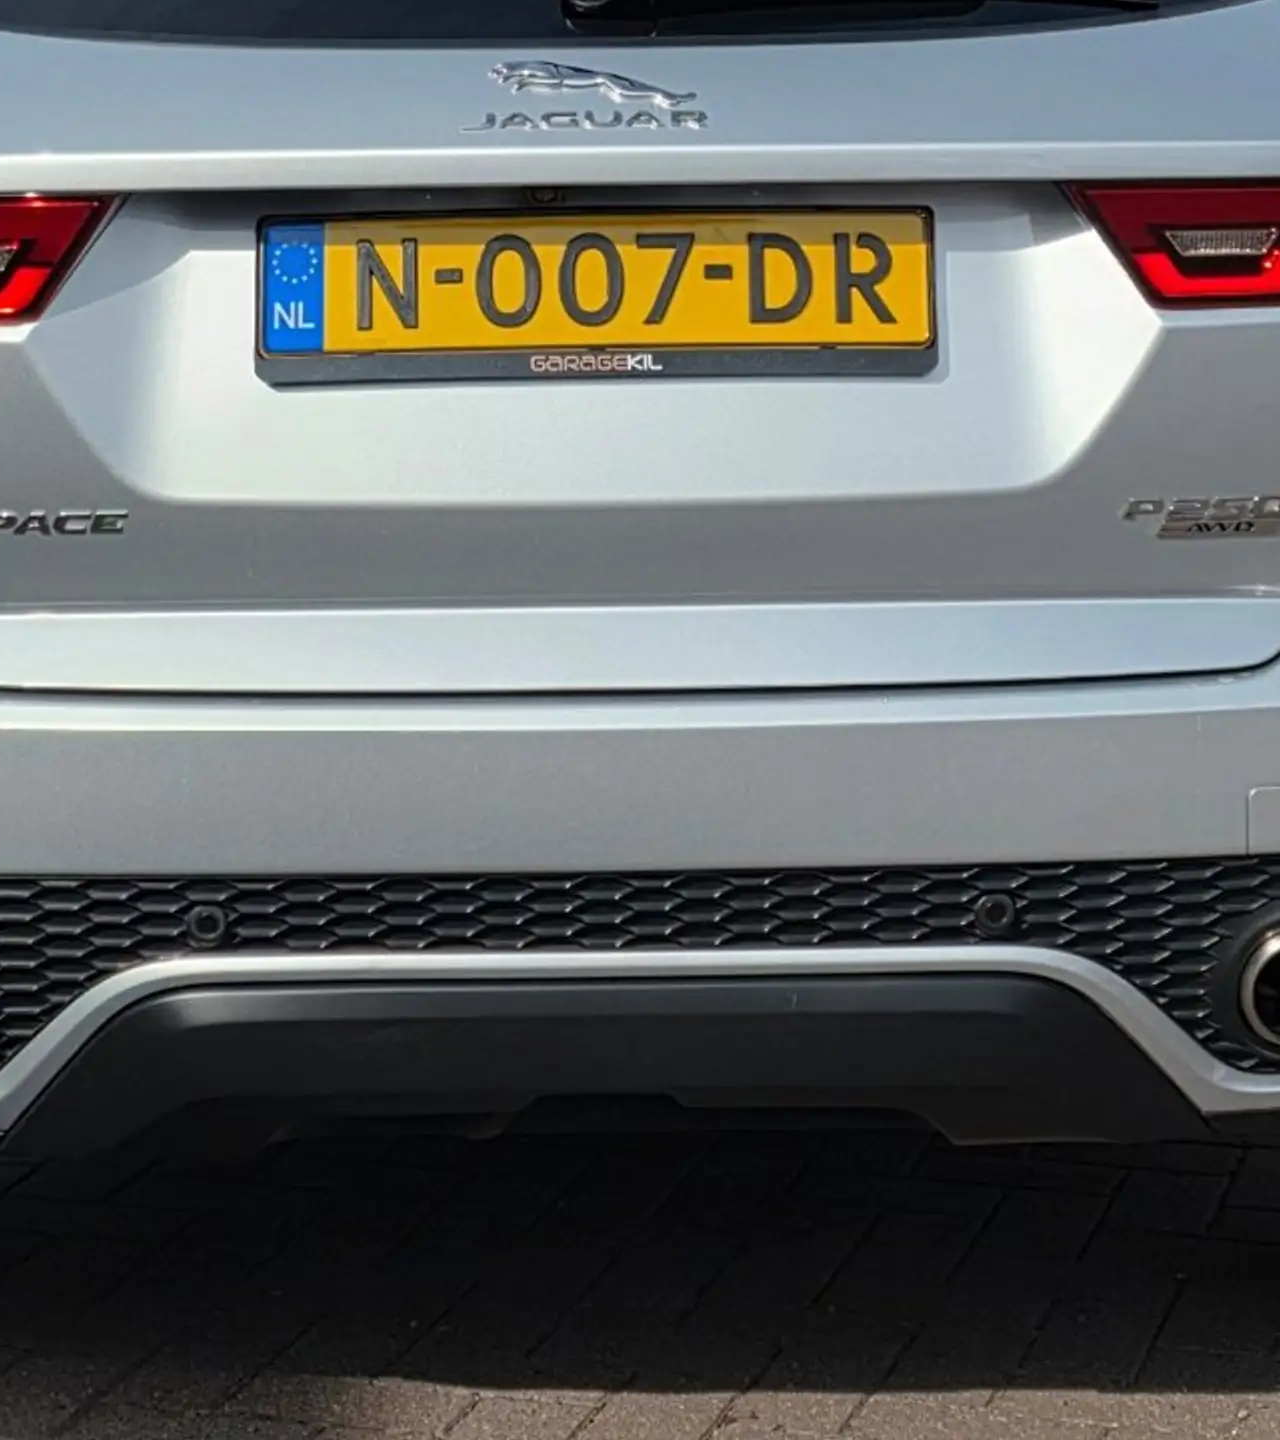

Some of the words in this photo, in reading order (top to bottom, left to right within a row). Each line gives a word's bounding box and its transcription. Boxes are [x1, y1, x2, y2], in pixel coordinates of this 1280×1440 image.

[460, 109, 710, 131] JAGUAR
[356, 231, 898, 331] N-007-DR
[274, 302, 315, 329] NL
